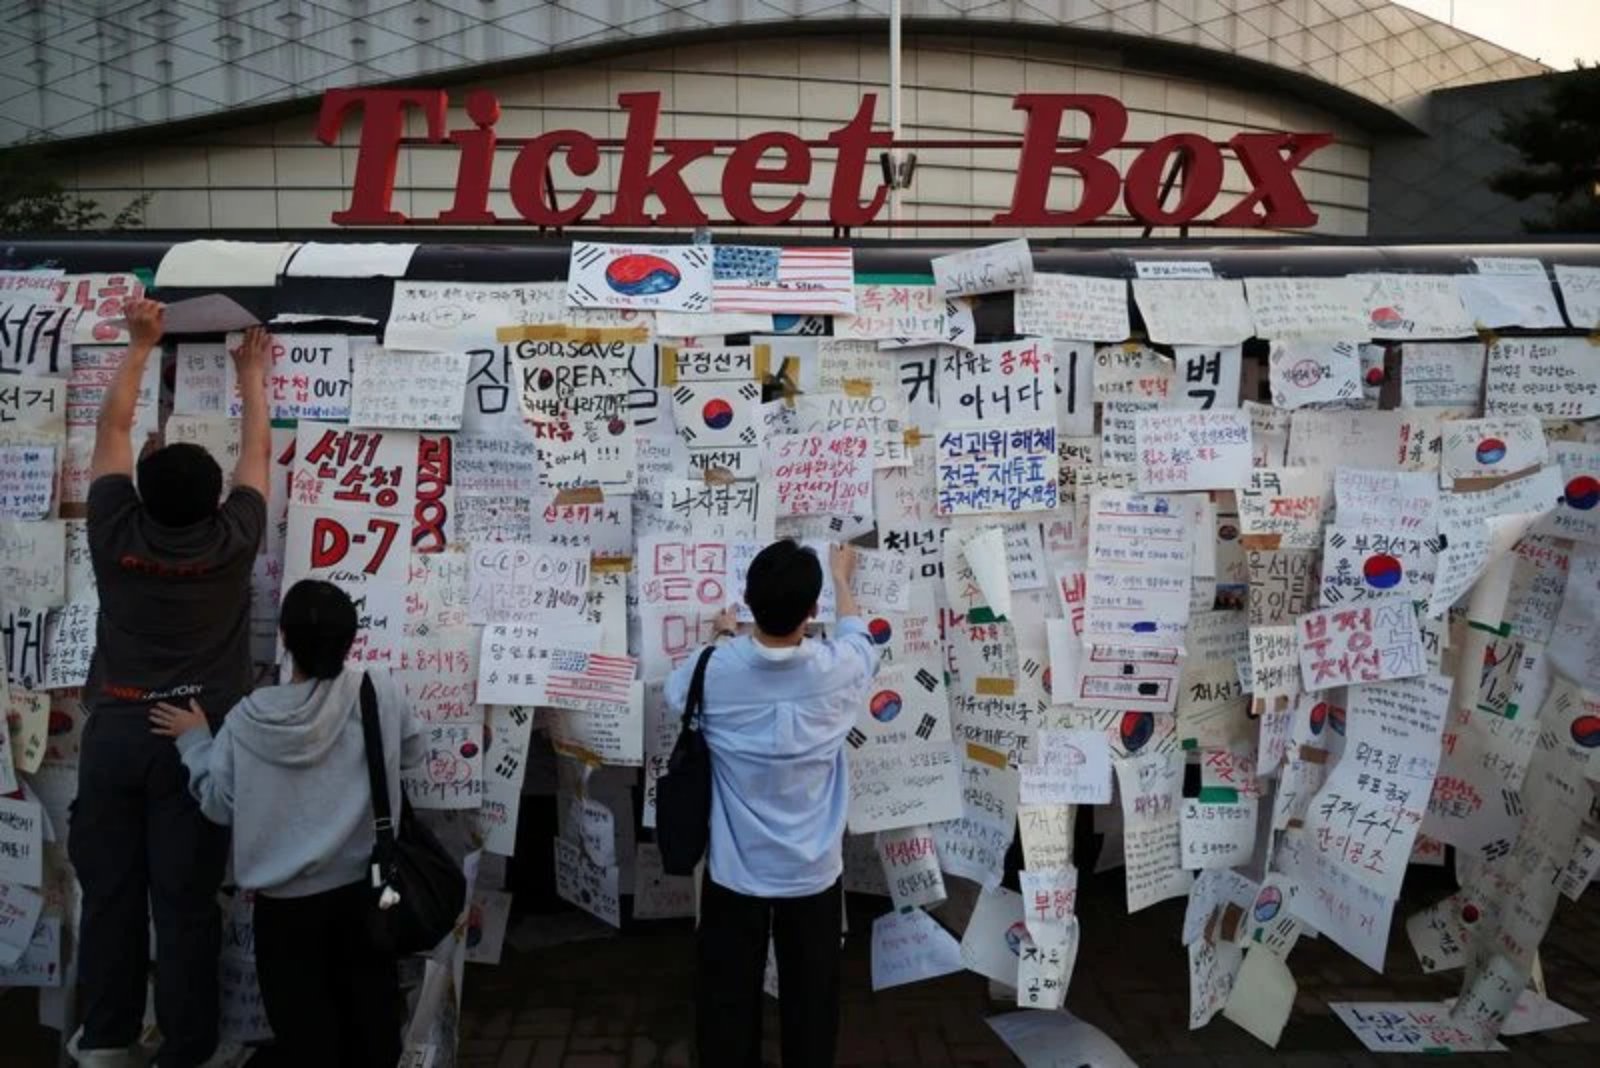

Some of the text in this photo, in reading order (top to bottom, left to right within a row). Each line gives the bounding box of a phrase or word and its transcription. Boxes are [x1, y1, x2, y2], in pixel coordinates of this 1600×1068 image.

[317, 88, 1335, 228] Ticket Box
[291, 346, 333, 365] OUT
[675, 353, 753, 376] 부정선거
[944, 350, 992, 381] 자유는
[313, 378, 351, 398] OUT
[960, 378, 1044, 420] 아니다
[1187, 352, 1221, 410] 벽
[305, 428, 383, 479] 선거
[690, 452, 741, 470] 재선거
[310, 517, 400, 575] D-7
